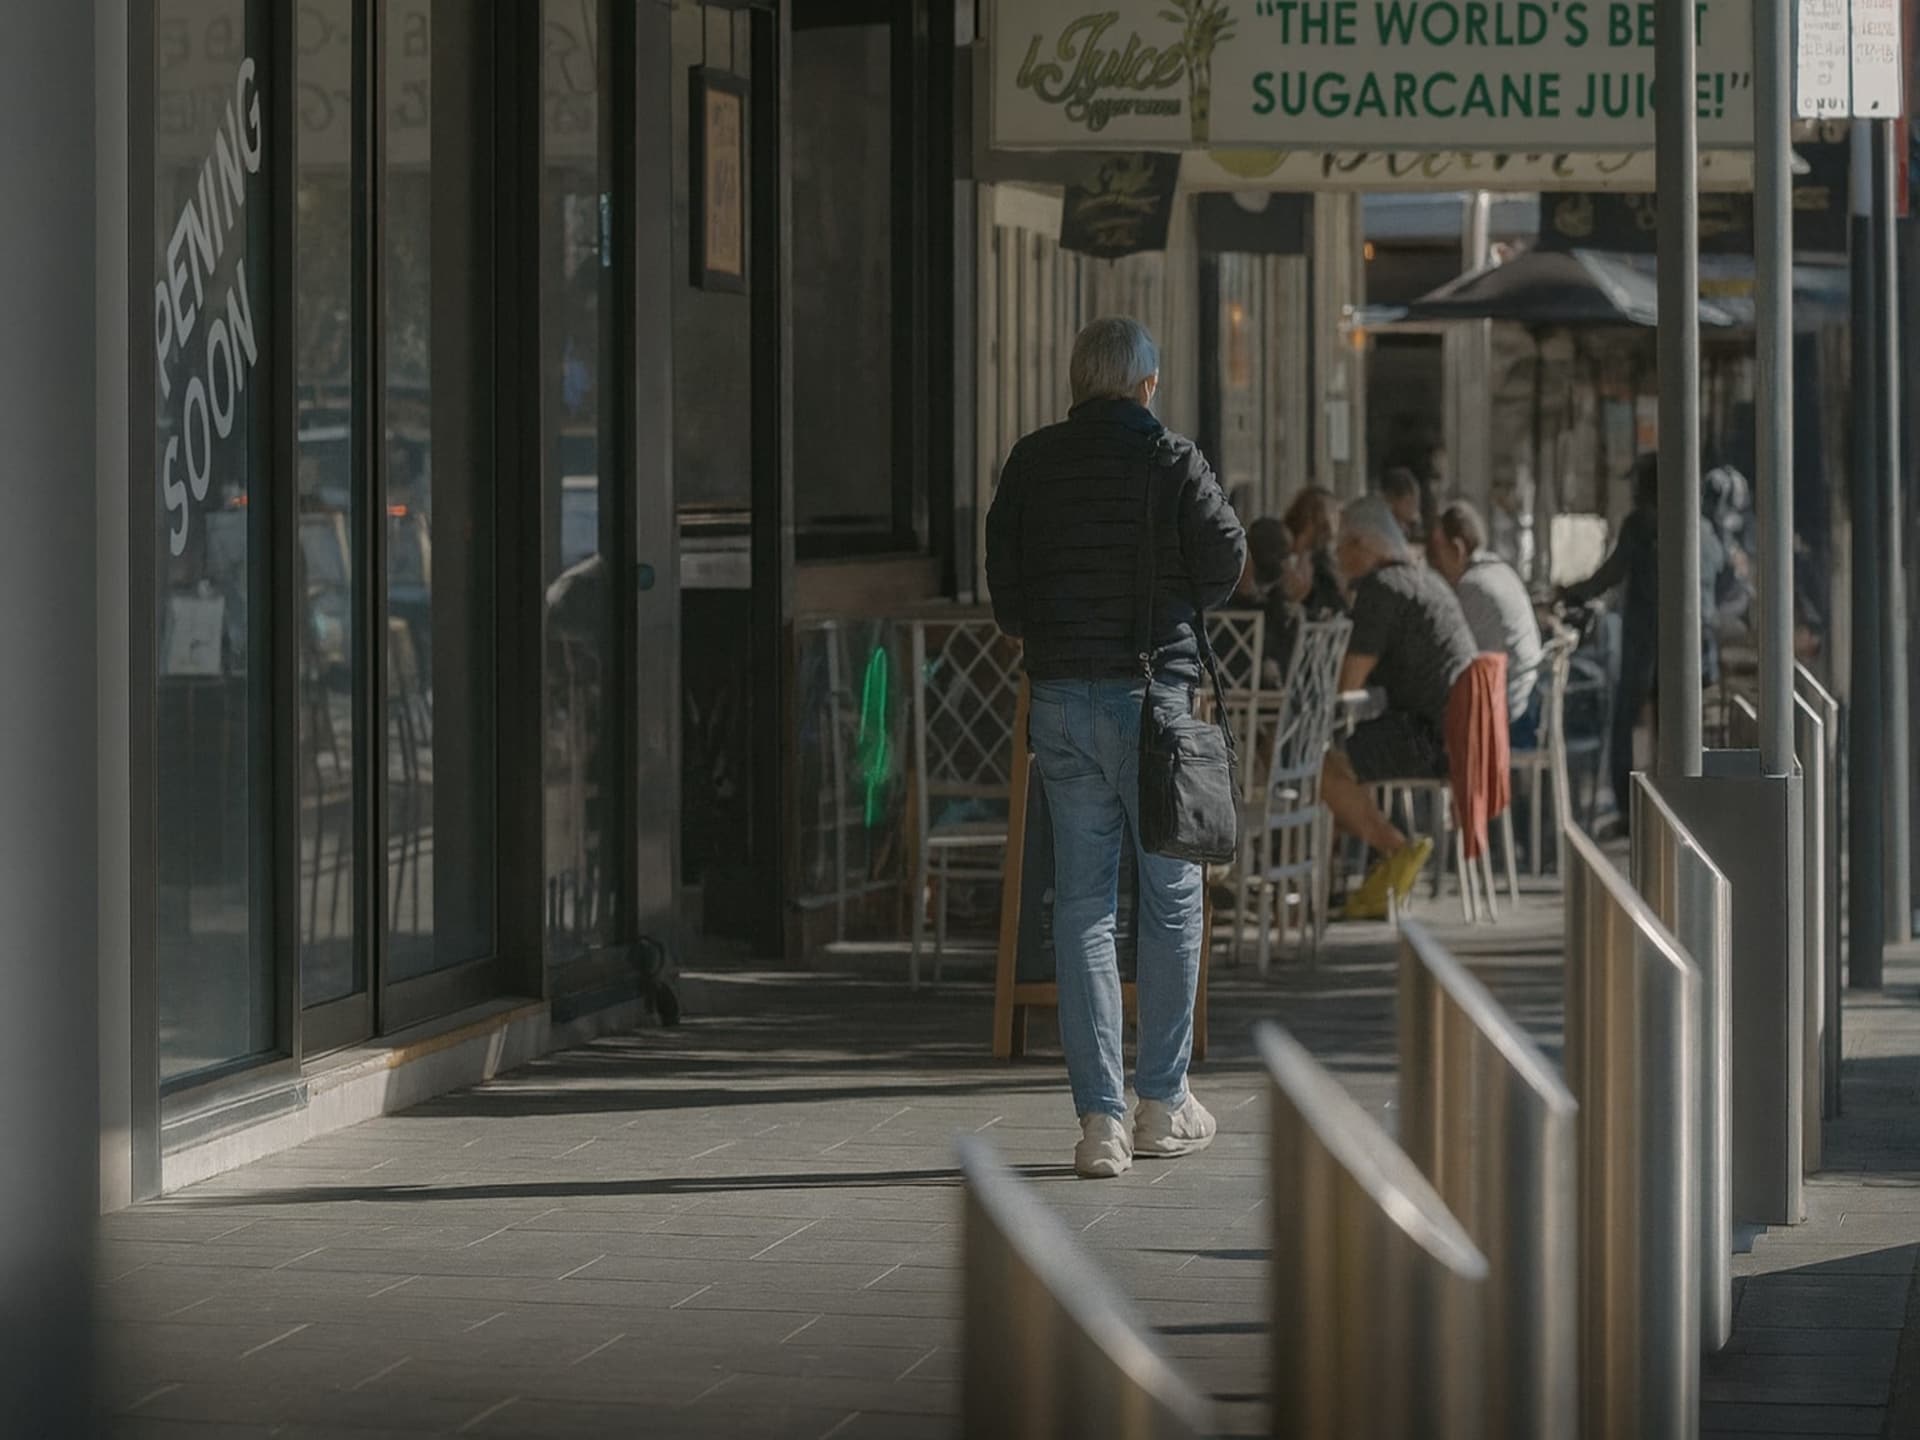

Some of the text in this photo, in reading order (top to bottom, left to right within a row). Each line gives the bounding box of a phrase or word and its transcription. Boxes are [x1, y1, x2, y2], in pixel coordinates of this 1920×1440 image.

[1375, 1, 1588, 47] WORLD'S
[1608, 2, 1708, 47] BET
[1252, 71, 1560, 118] SUGARCANE
[163, 257, 258, 556] SOON
